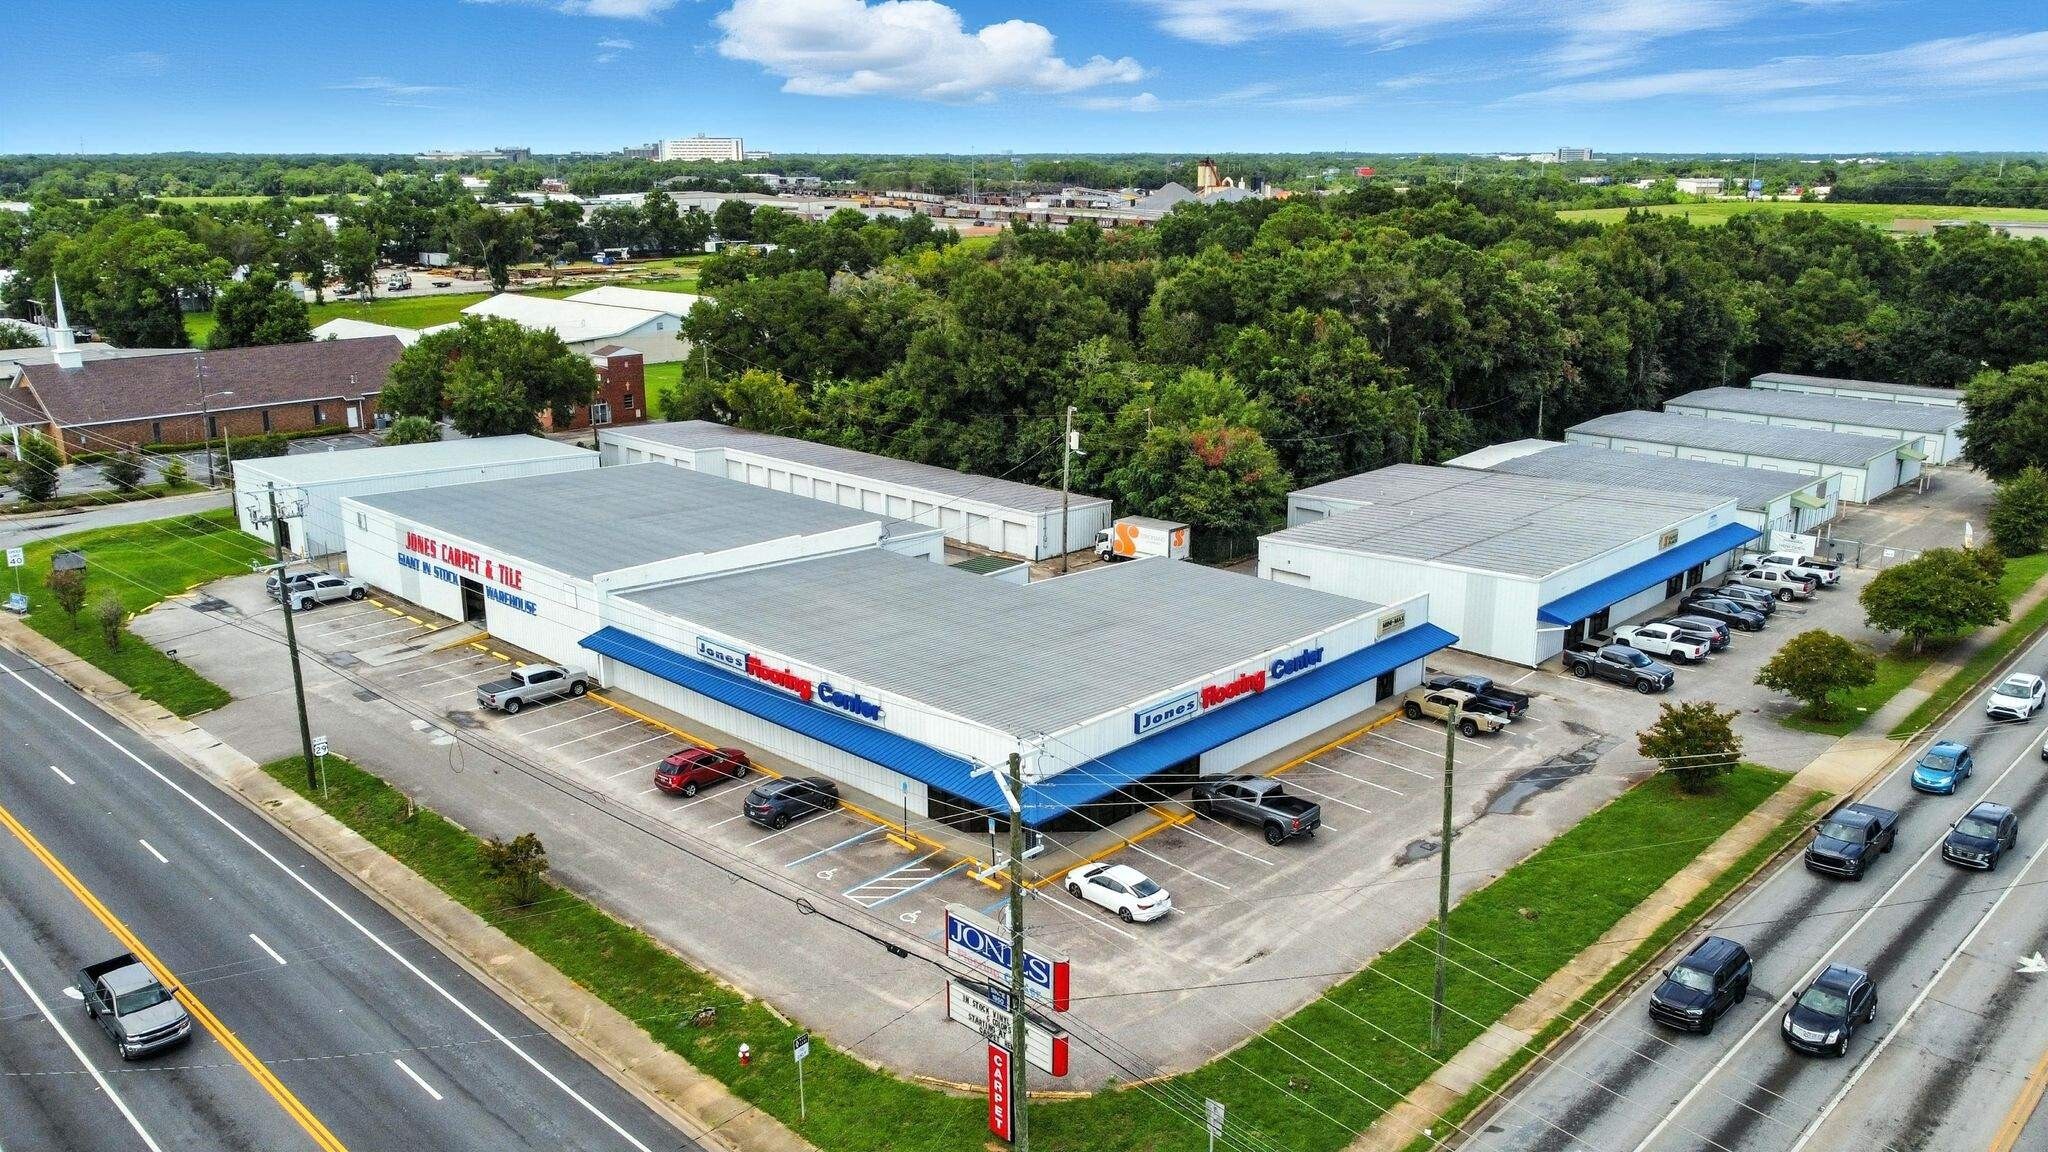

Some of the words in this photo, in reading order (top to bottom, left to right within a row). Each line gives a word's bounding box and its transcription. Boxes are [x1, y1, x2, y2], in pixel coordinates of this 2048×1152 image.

[398, 552, 420, 571] GIANT
[422, 561, 432, 576] IN
[433, 565, 460, 586] STOCK
[485, 585, 538, 616] WAREHOUSE
[405, 531, 437, 558] JONES
[441, 543, 480, 574] CARPET
[485, 559, 494, 580] &
[498, 563, 522, 590] TILE
[699, 641, 744, 668] Jones
[748, 656, 812, 704] Flooring
[818, 681, 881, 721] Center
[1142, 699, 1195, 728] Jones
[1201, 670, 1266, 709] Flooring
[1271, 647, 1324, 679] Center
[316, 745, 327, 754] 29
[962, 994, 970, 1004] IN
[972, 1000, 990, 1015] STOCK
[992, 1010, 1010, 1026] VINYL
[968, 1013, 996, 1033] STARTING
[998, 1030, 1007, 1040] AT
[993, 1055, 1003, 1130] CARPET
